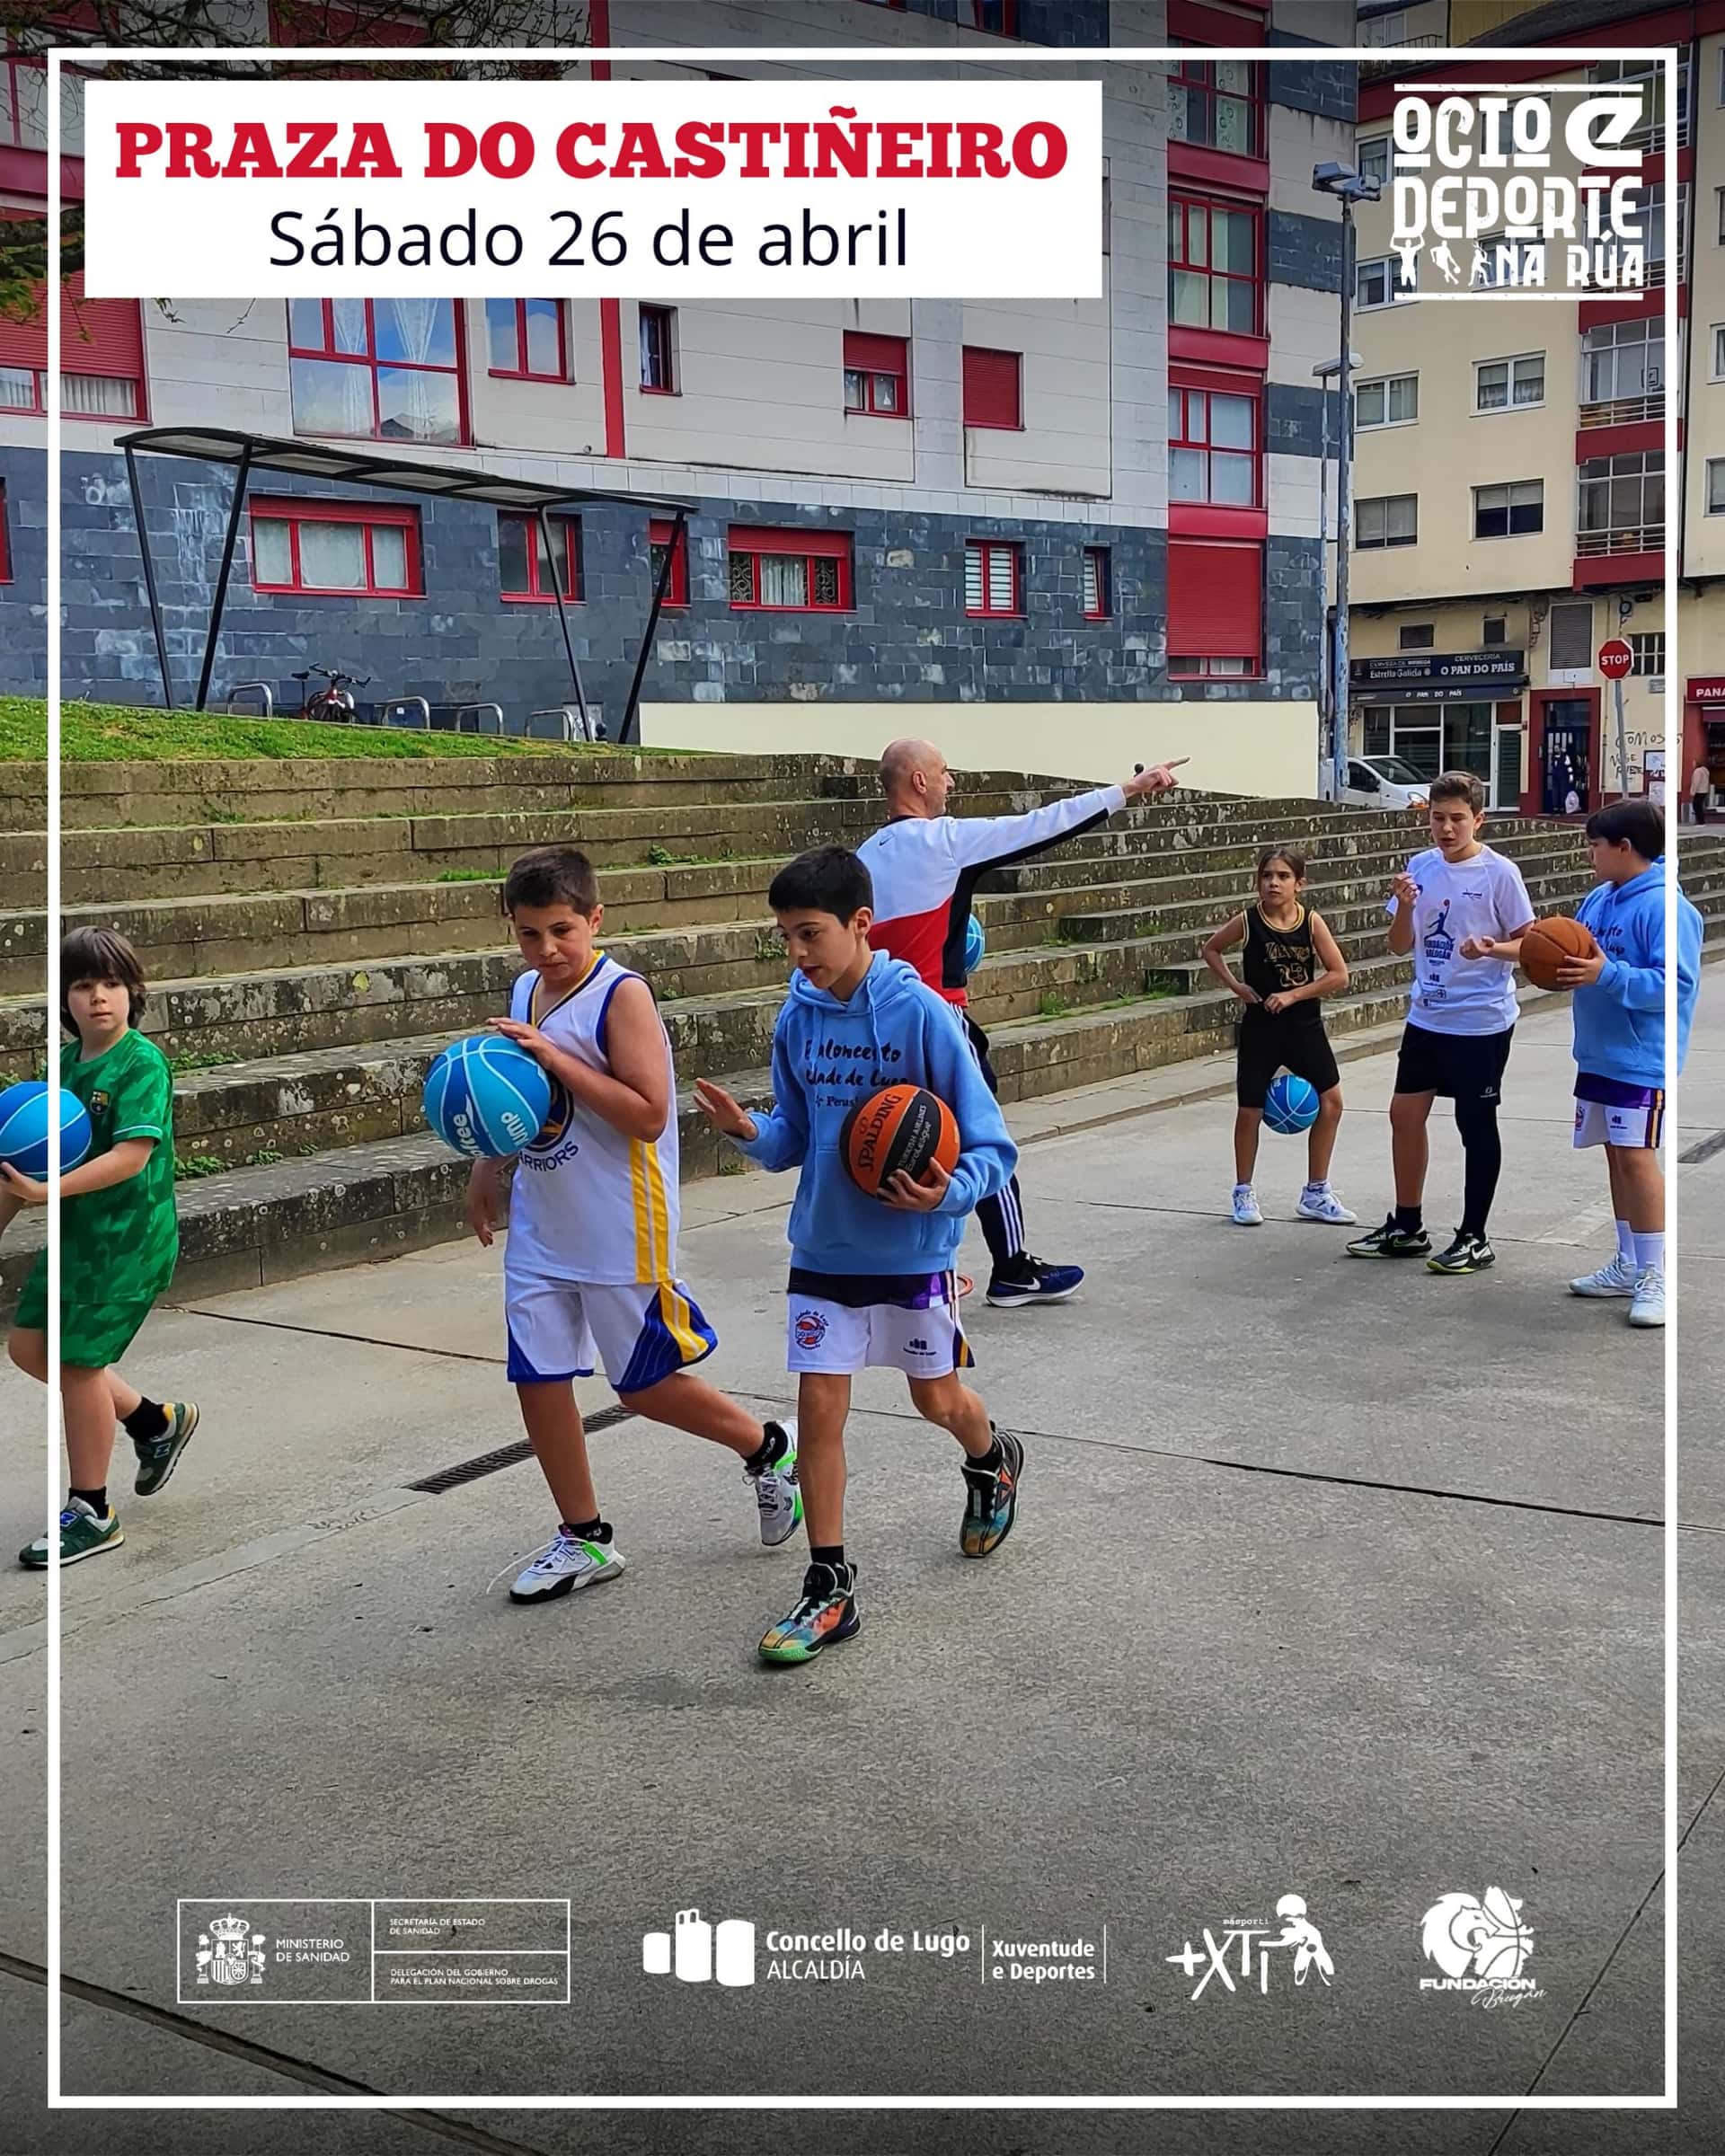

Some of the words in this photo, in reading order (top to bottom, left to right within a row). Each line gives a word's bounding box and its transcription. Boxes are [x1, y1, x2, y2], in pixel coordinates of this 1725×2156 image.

[1440, 667, 1449, 676] O
[1451, 665, 1471, 675] PAN
[1473, 664, 1489, 674] DO
[1491, 660, 1515, 673] PAÍS
[1601, 654, 1629, 666] STOP
[857, 1093, 904, 1172] SPALDING
[518, 1140, 579, 1172] ARRIORS
